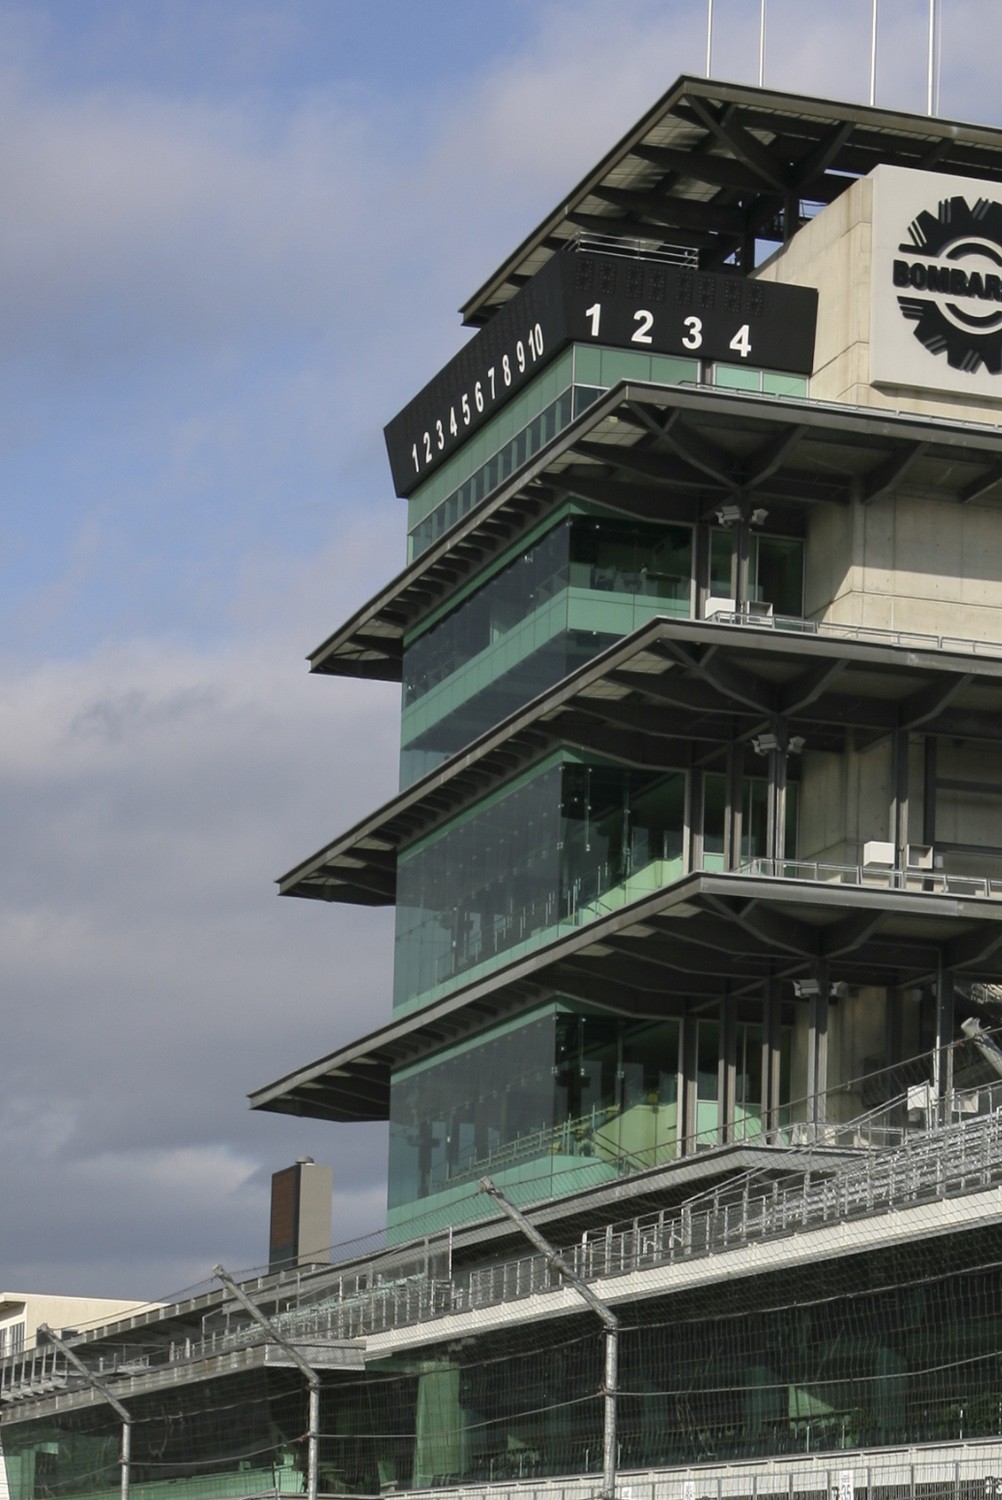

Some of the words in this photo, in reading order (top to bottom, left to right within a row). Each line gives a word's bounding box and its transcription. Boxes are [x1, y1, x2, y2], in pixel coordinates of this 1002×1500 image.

[585, 303, 601, 336] 1
[631, 309, 654, 344] 2
[681, 316, 703, 350] 3
[729, 324, 752, 357] 4
[412, 443, 419, 472] 1
[423, 431, 432, 463] 2
[436, 419, 444, 450] 3
[450, 406, 457, 436] 4
[462, 393, 470, 425] 5
[475, 381, 484, 412] 6
[488, 366, 495, 399] 7
[502, 354, 511, 386] 8
[516, 340, 525, 373] 9
[528, 323, 544, 362] 10
